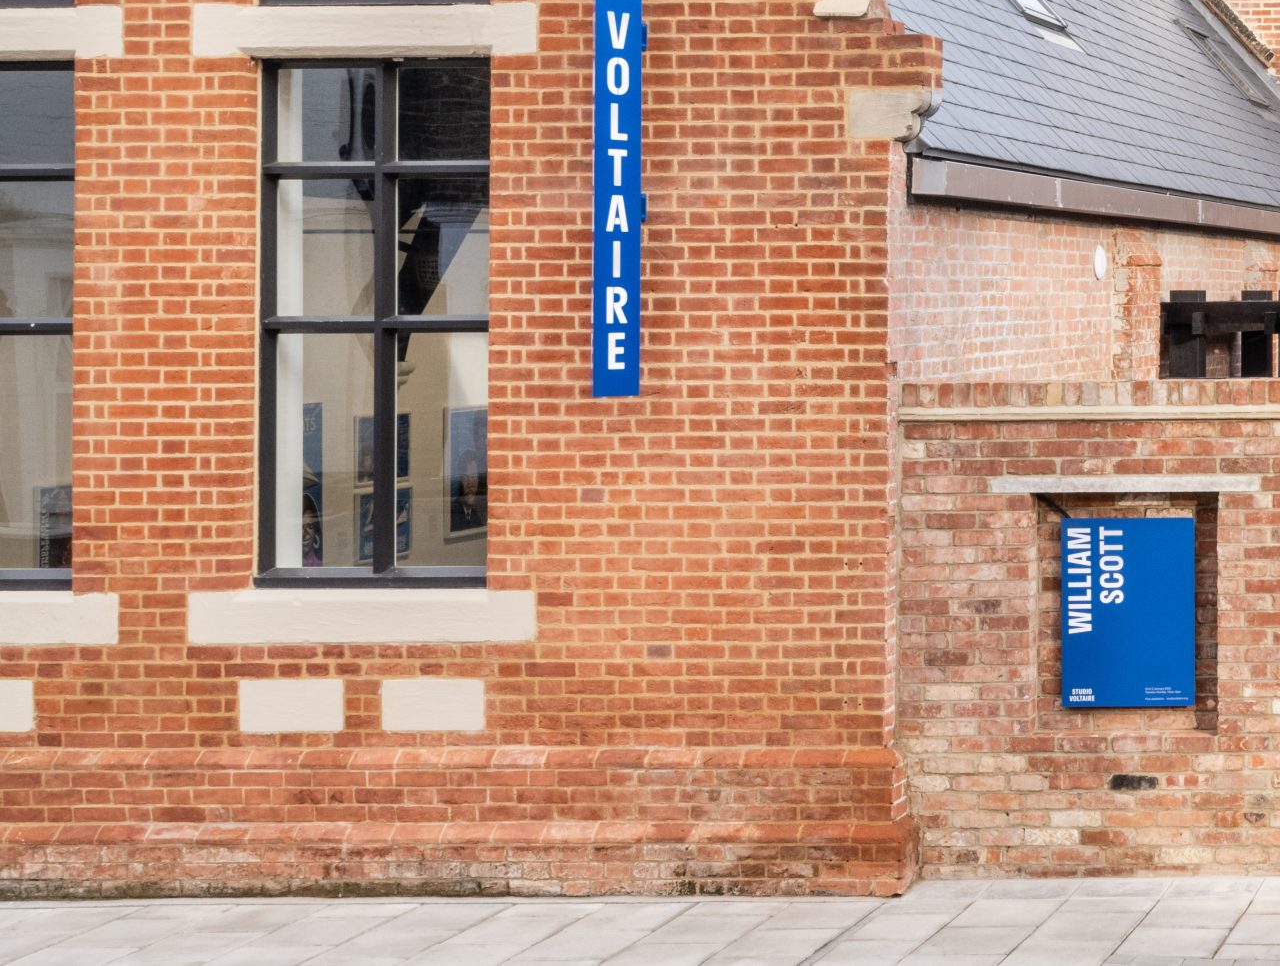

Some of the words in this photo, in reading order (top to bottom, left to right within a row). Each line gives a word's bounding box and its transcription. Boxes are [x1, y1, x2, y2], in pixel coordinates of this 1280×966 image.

[606, 10, 631, 371] VOLTAIRE
[1067, 527, 1093, 635] WILLIAM
[1099, 526, 1124, 604] SCOTT
